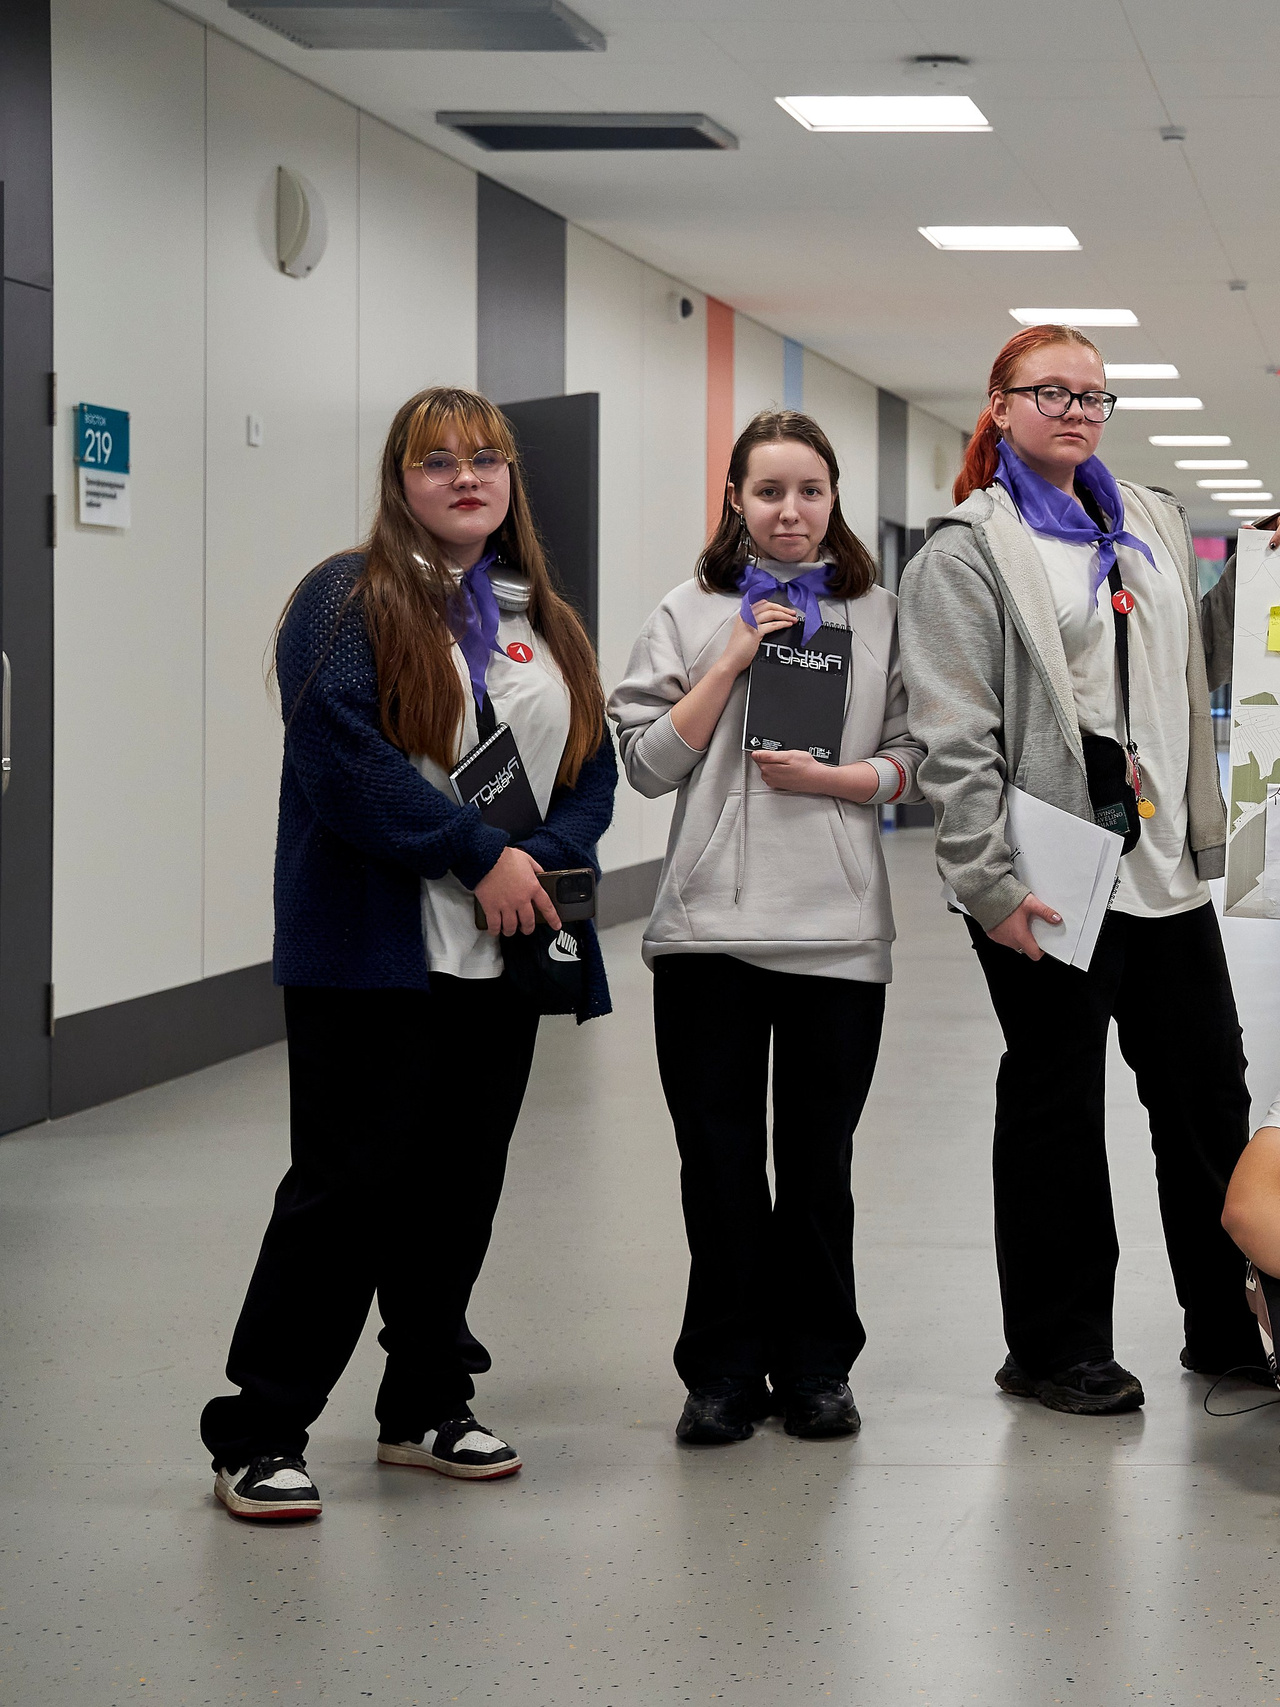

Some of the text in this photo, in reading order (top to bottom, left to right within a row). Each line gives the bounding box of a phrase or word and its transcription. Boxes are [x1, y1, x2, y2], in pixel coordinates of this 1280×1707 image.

[84, 428, 113, 465] 219
[760, 641, 842, 670] ТОЧКА
[468, 755, 520, 809] ТОЧКА
